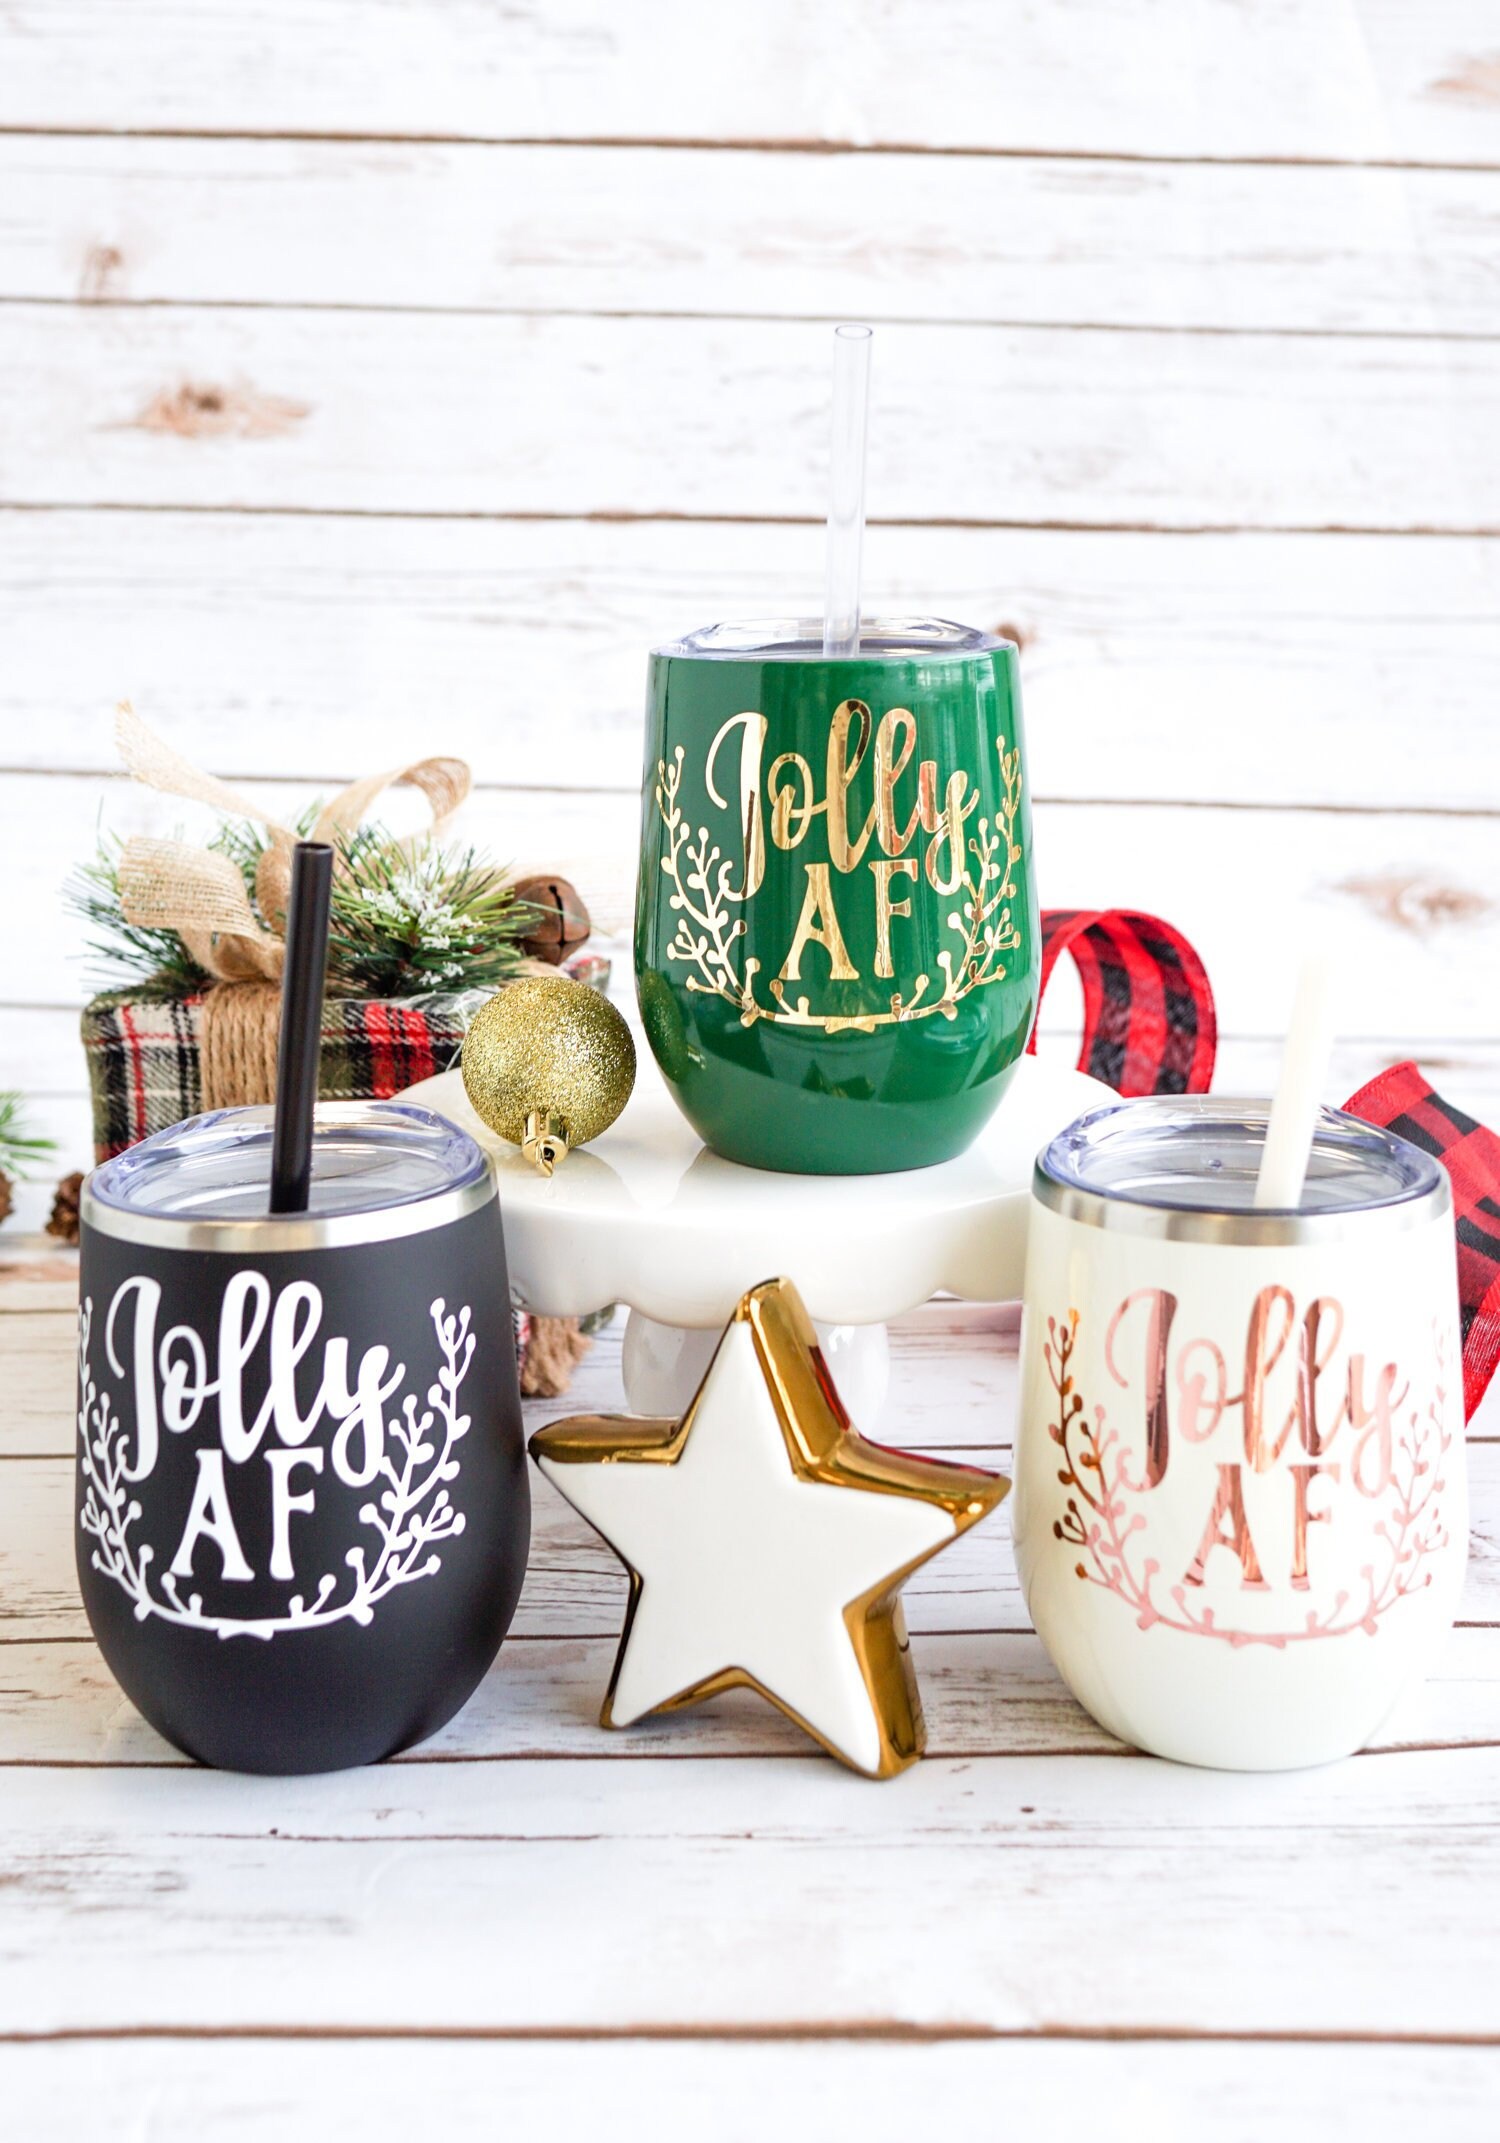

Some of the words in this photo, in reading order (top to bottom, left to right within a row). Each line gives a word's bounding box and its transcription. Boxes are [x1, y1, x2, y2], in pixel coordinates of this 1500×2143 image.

[706, 699, 979, 901] Jolly
[778, 858, 918, 980] AF
[105, 1270, 406, 1488] Jolly
[1104, 1284, 1410, 1498] Jolly
[169, 1447, 324, 1581] AF
[1181, 1462, 1341, 1591] AF
